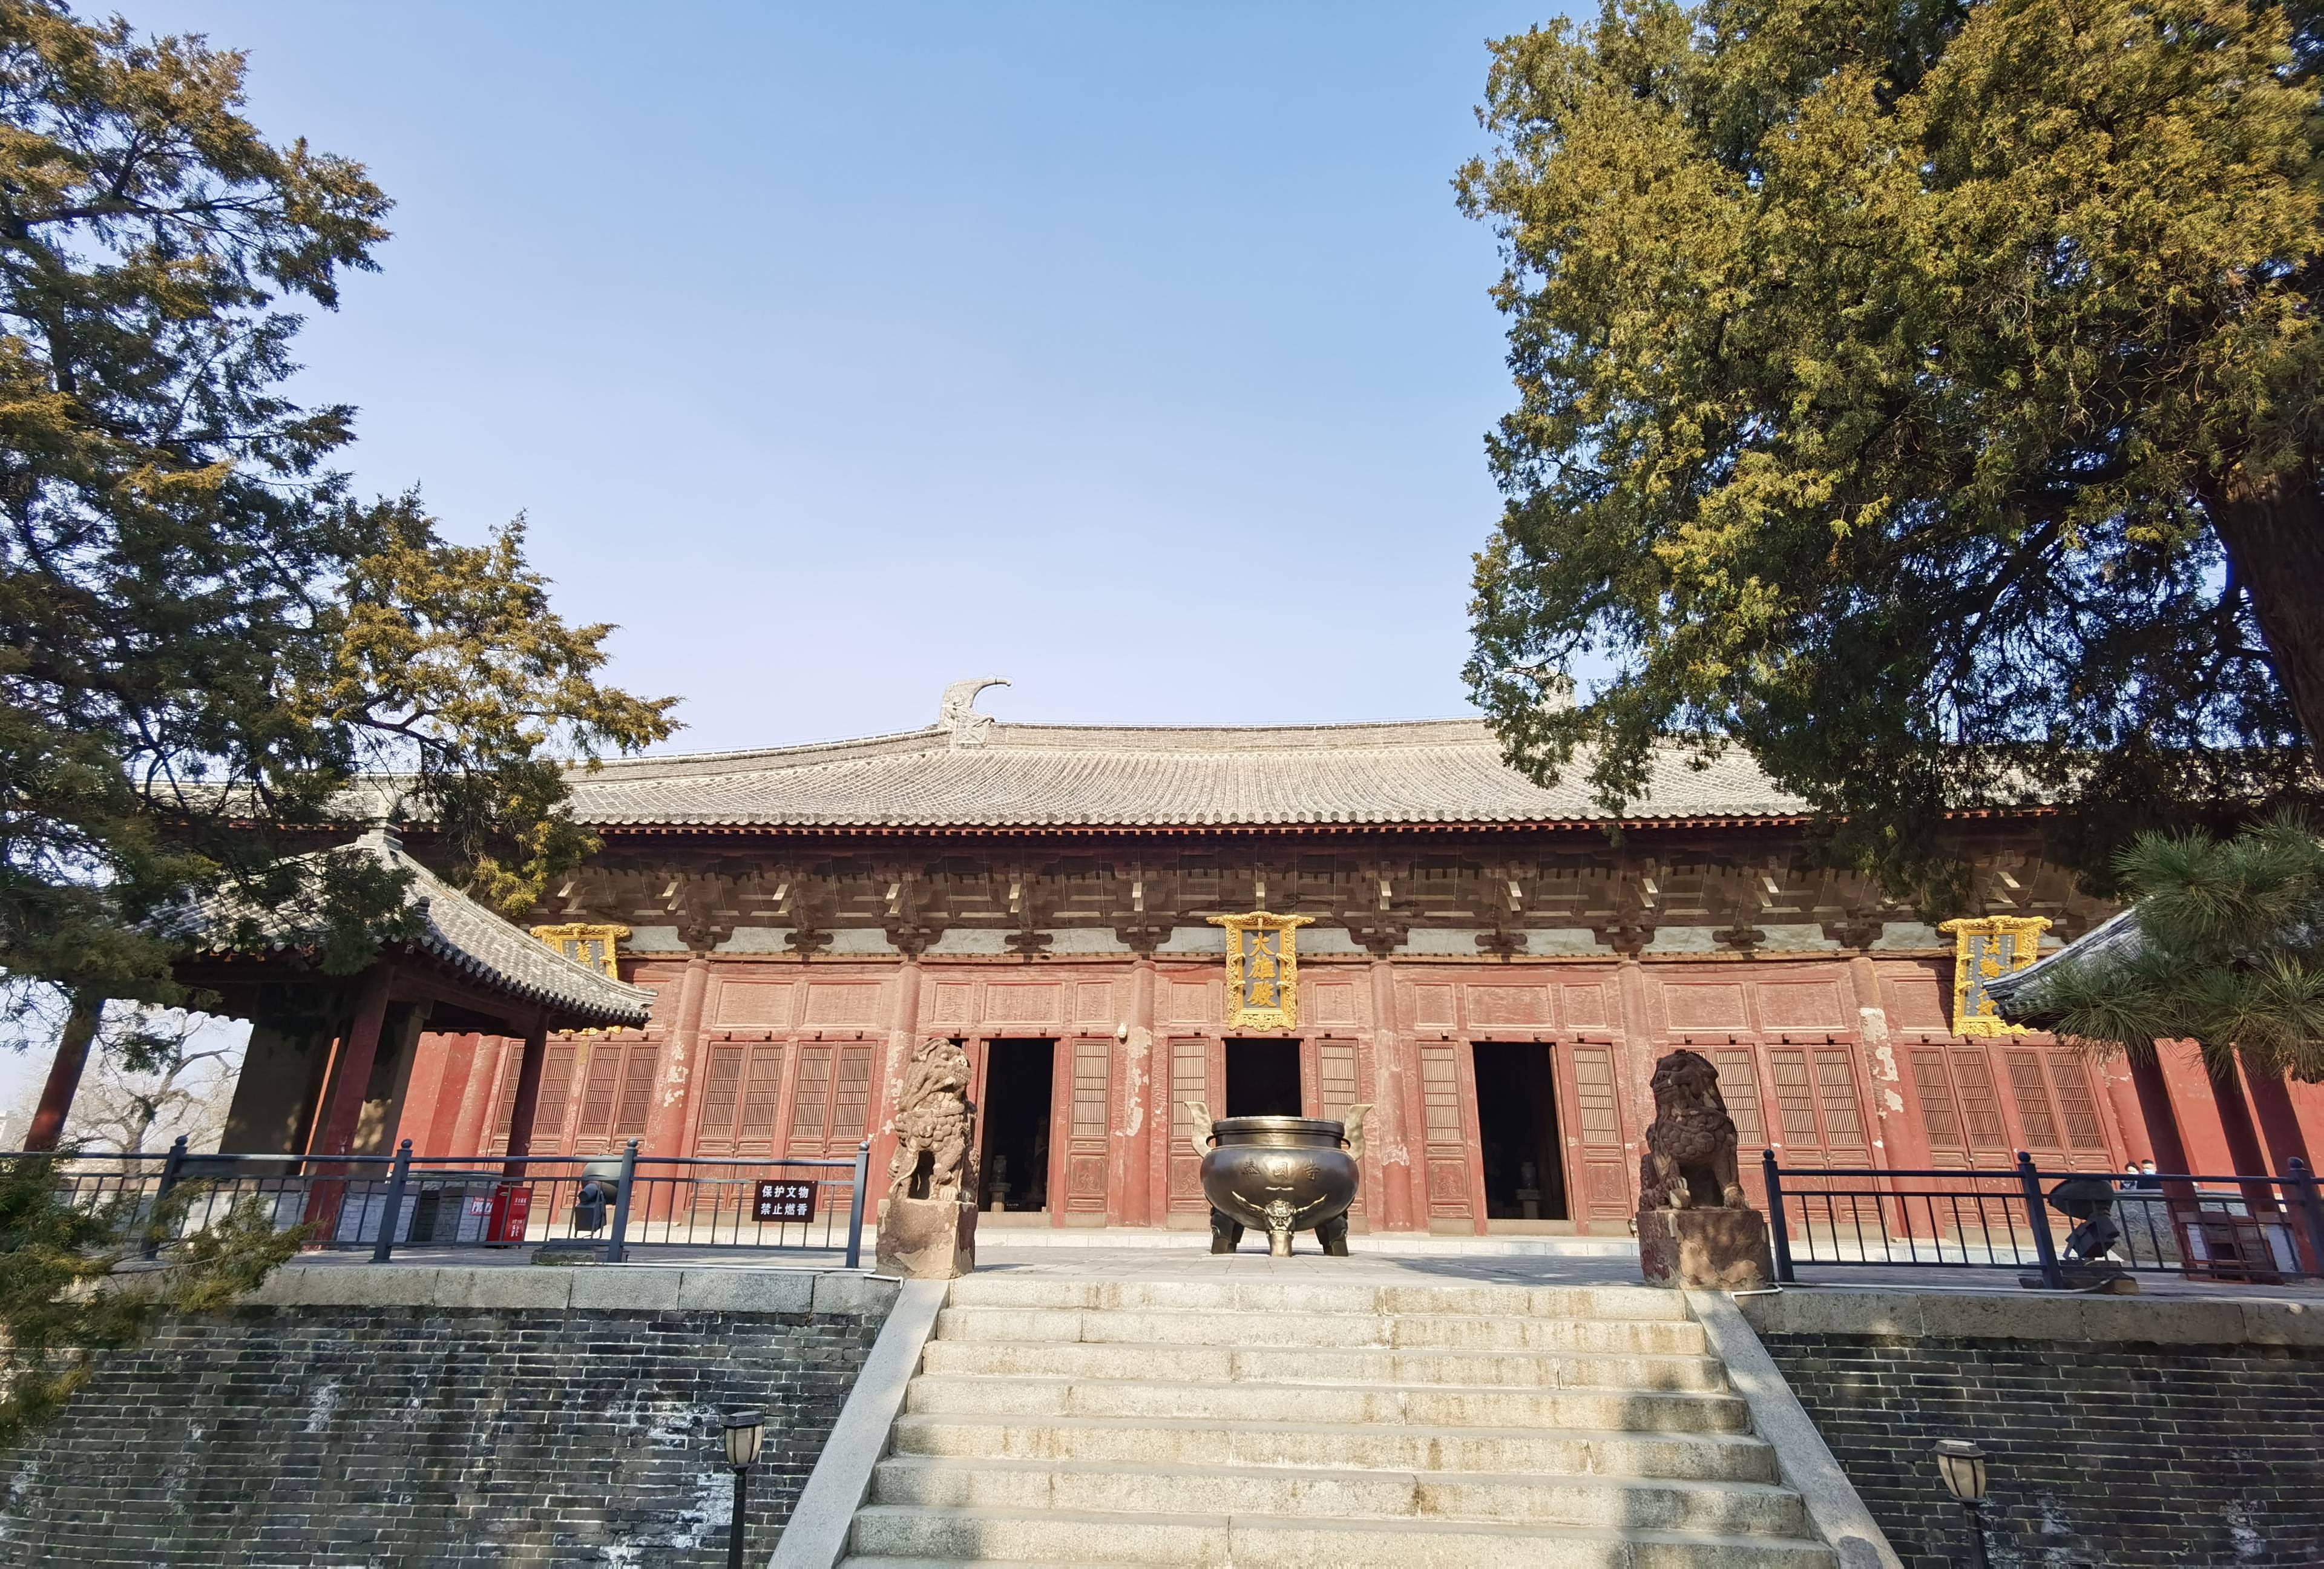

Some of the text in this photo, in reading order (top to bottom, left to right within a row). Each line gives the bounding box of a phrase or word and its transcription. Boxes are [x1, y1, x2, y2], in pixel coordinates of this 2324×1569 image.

[1247, 932, 1276, 1007] 大雄殿
[761, 1185, 809, 1199] 保护文物
[760, 1202, 808, 1216] 禁止燃香
